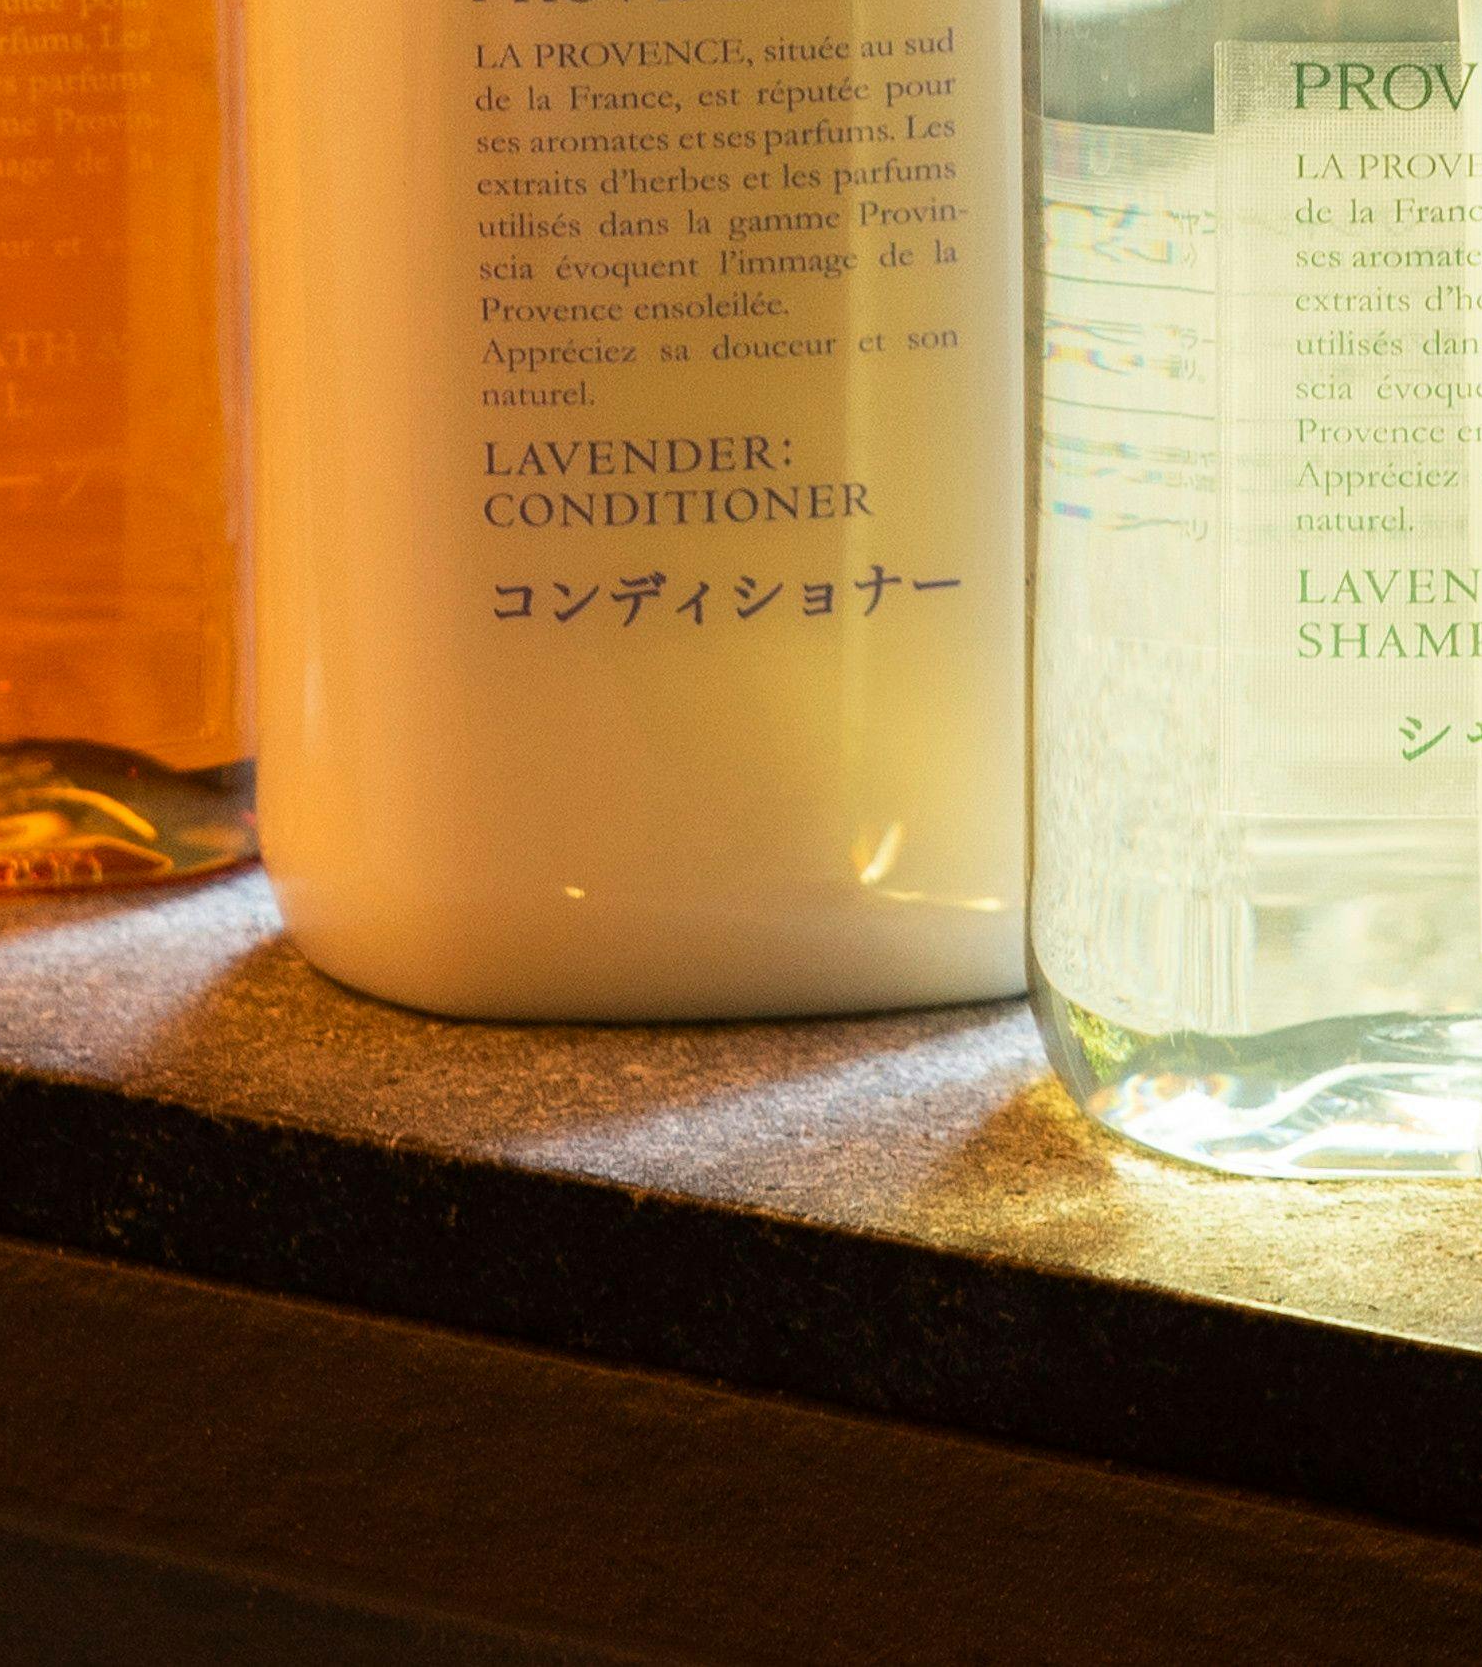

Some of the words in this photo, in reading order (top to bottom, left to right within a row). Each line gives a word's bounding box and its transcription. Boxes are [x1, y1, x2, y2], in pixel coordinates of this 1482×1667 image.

[476, 43, 522, 70] LA
[533, 37, 754, 69] PROVENCE,
[764, 35, 850, 64] située
[861, 39, 893, 58] au
[905, 27, 954, 55] sud
[476, 86, 510, 112] de
[527, 85, 550, 111] la
[569, 84, 682, 114] France,
[698, 86, 736, 106] est
[757, 76, 869, 113] réputée
[886, 78, 956, 106] pour
[477, 135, 519, 154] ses
[530, 129, 669, 153] aromates
[679, 130, 704, 150] et
[712, 128, 756, 149] ses
[764, 119, 895, 154] parfums.
[905, 114, 955, 140] Les
[477, 171, 587, 196] extraits
[599, 166, 731, 195] d'herbes
[743, 168, 770, 189] et
[782, 163, 820, 188] les
[833, 159, 956, 197] parfums
[1297, 153, 1344, 180] LA
[478, 211, 581, 239] utilisés
[599, 210, 669, 237] dans
[687, 210, 710, 234] la
[729, 208, 840, 239] gamme
[859, 199, 969, 227] Provin-
[1296, 199, 1332, 223] de
[1350, 198, 1374, 223] la
[479, 255, 532, 282] scia
[556, 252, 699, 287] évoquent
[720, 247, 857, 280] l'immage
[879, 241, 914, 267] de
[935, 239, 957, 264] la
[1296, 248, 1341, 268] ses
[481, 297, 622, 322] Provence
[634, 293, 789, 321] ensoleilée.
[1296, 288, 1411, 311] extraits
[482, 338, 637, 371] Appréciez
[660, 342, 689, 361] sa
[712, 333, 836, 359] douceur
[859, 333, 884, 353] et
[908, 328, 959, 349] son
[1296, 330, 1403, 356] utilisés
[482, 382, 595, 407] naturel.
[1296, 377, 1353, 400] scia
[1297, 418, 1445, 444] Provence
[483, 437, 792, 476] LAVENDER:
[1296, 461, 1460, 496] Appréciez
[483, 482, 874, 528] CONDITIONER
[1296, 507, 1414, 533] naturel.
[494, 563, 962, 627] コンディショナー
